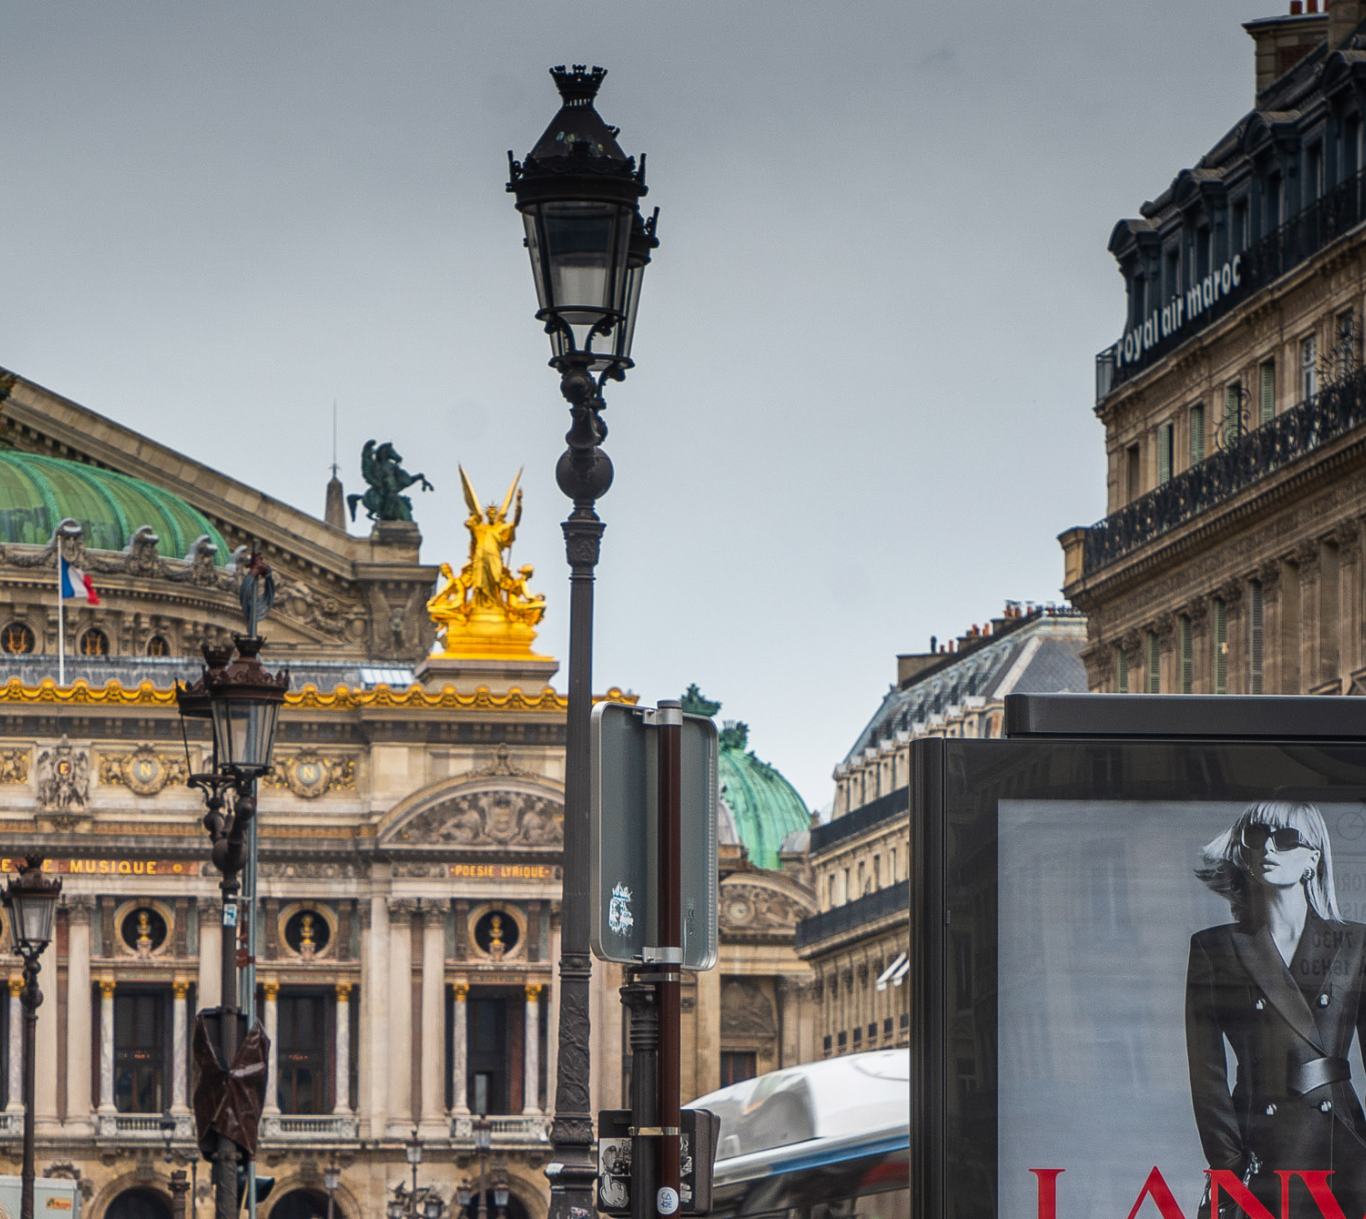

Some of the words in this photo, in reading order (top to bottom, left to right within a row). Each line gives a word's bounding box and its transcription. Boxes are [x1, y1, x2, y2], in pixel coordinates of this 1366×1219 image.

[1117, 310, 1159, 368] royal
[1162, 295, 1184, 337] air
[1187, 254, 1241, 321] maroc
[69, 859, 157, 875] MUSIQUE
[455, 864, 495, 877] POESIE
[501, 866, 545, 878] LYRIQUE
